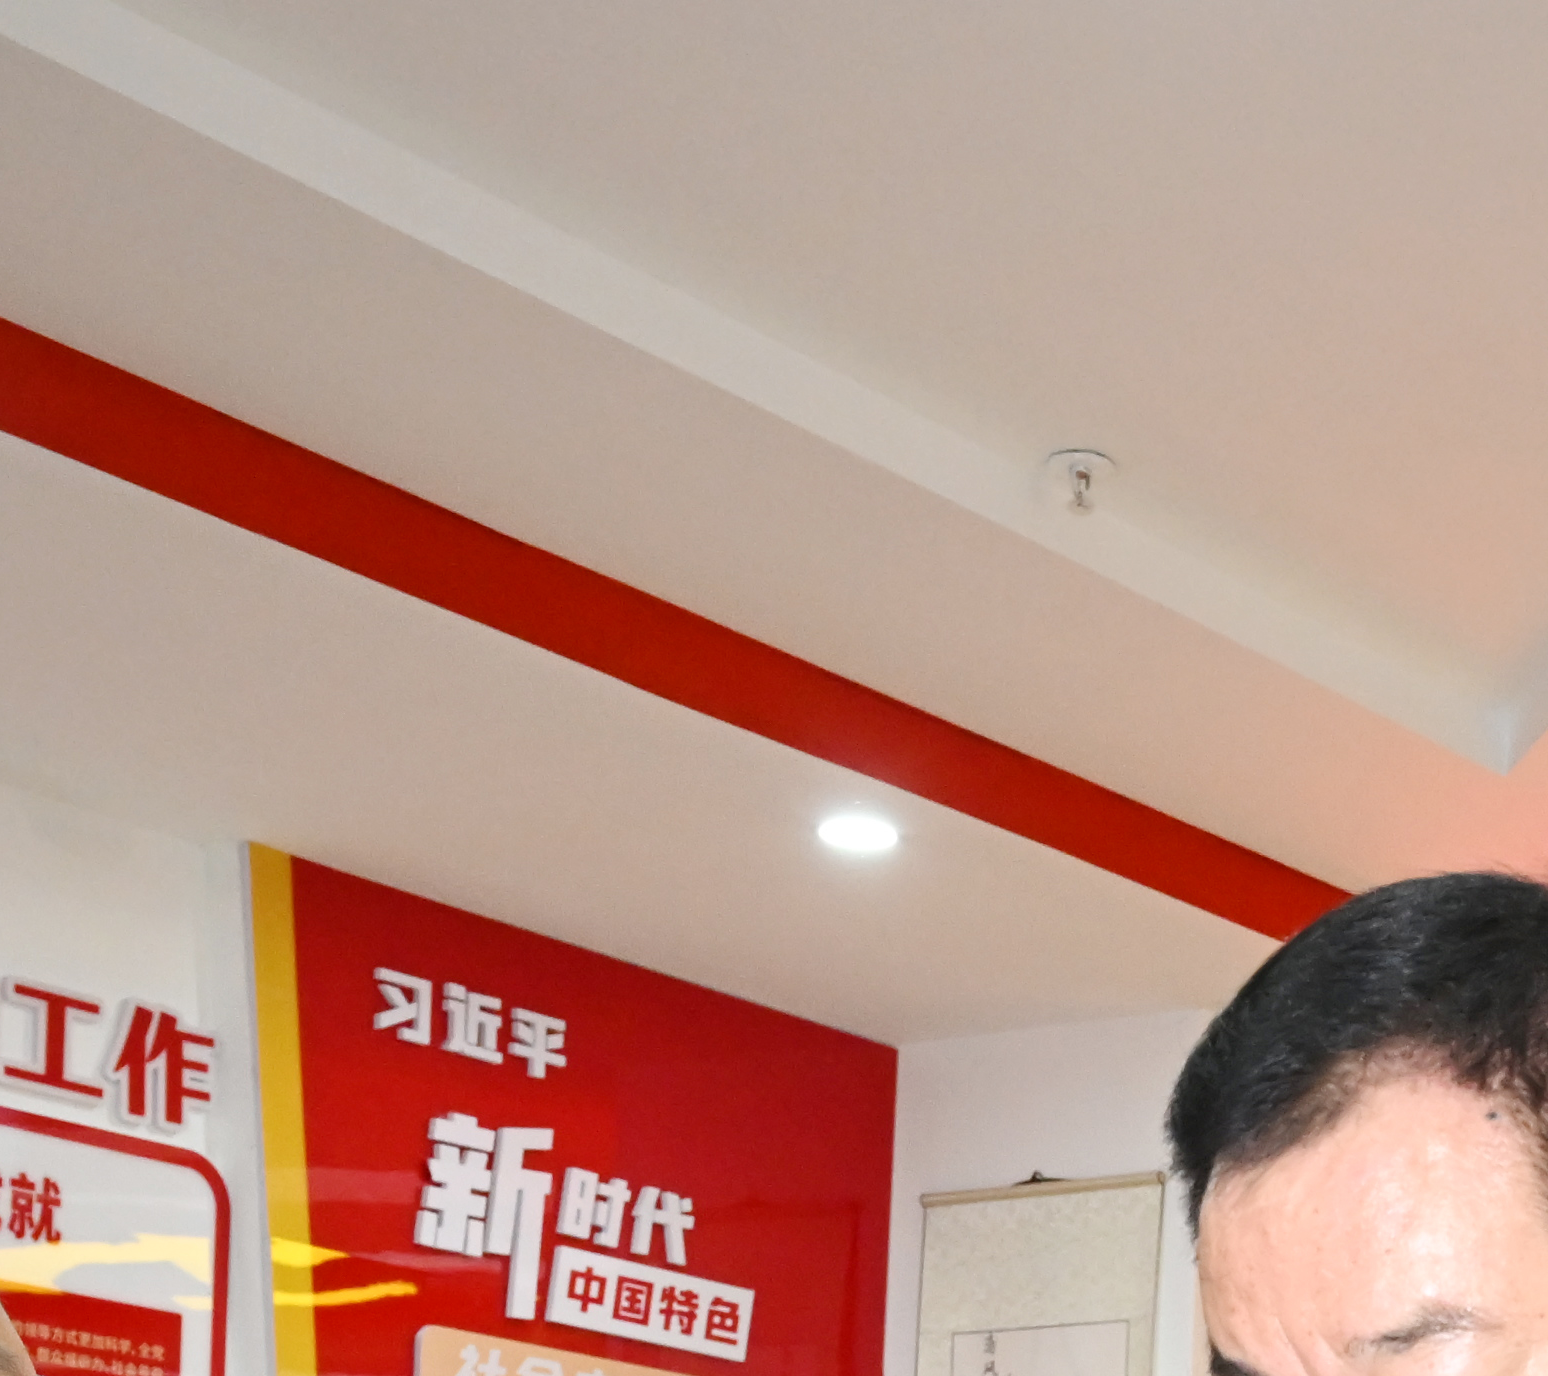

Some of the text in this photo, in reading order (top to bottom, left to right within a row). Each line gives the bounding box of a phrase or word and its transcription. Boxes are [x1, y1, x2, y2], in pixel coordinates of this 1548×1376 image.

[372, 966, 568, 1080] 习近平
[566, 1265, 741, 1347] 中国特色
